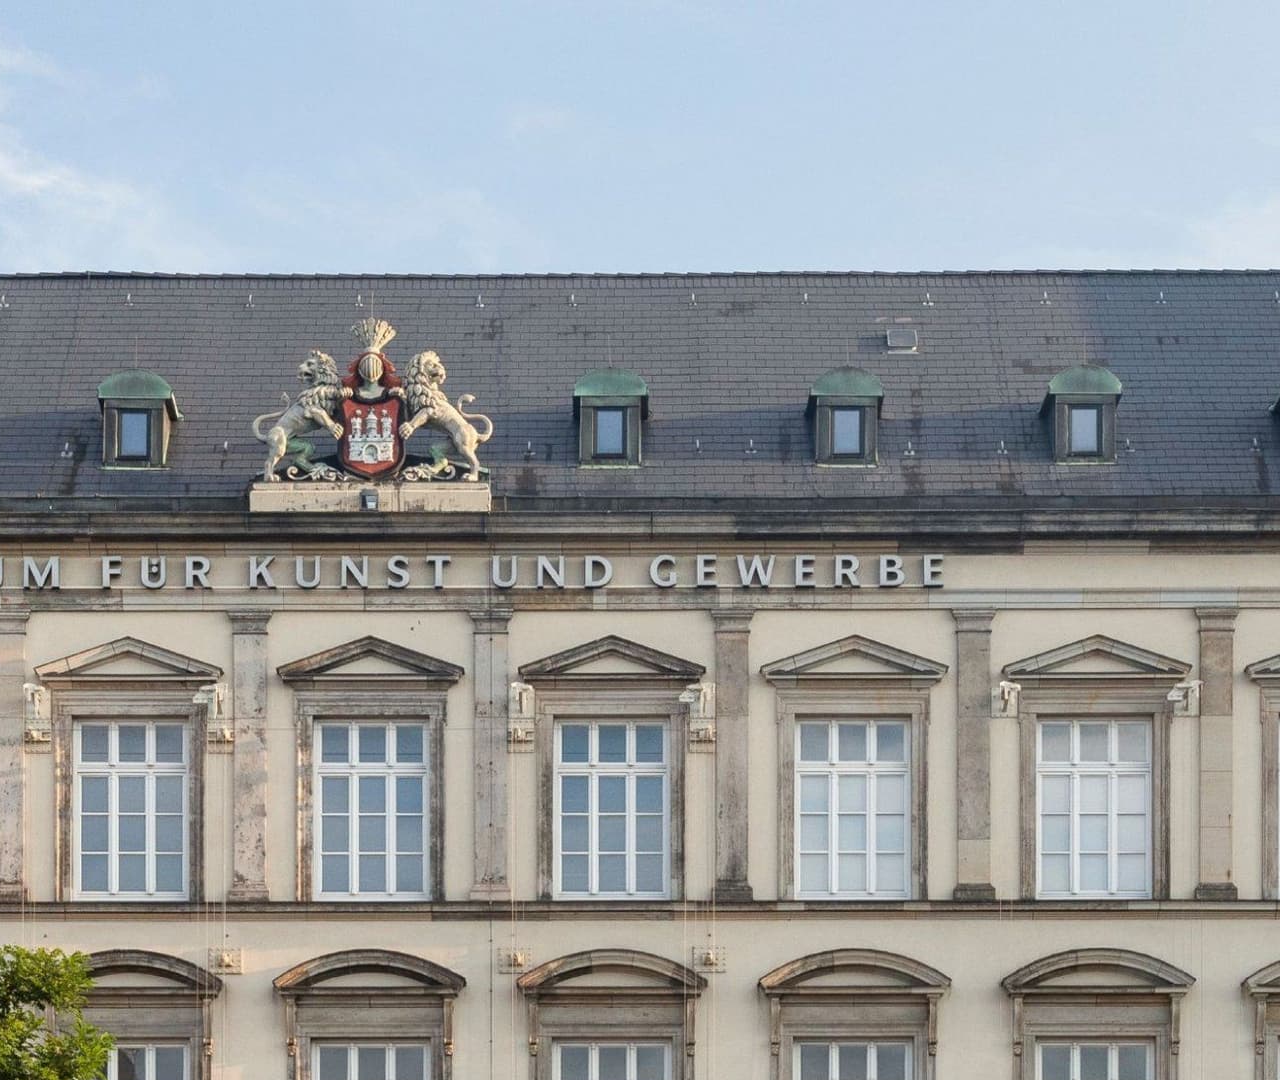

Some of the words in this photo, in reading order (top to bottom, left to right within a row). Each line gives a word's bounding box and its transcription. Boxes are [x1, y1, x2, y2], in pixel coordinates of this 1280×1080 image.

[101, 555, 213, 589] FÜR
[248, 555, 451, 589] KUNST
[491, 555, 613, 589] UND
[649, 555, 944, 589] GEWERBE
